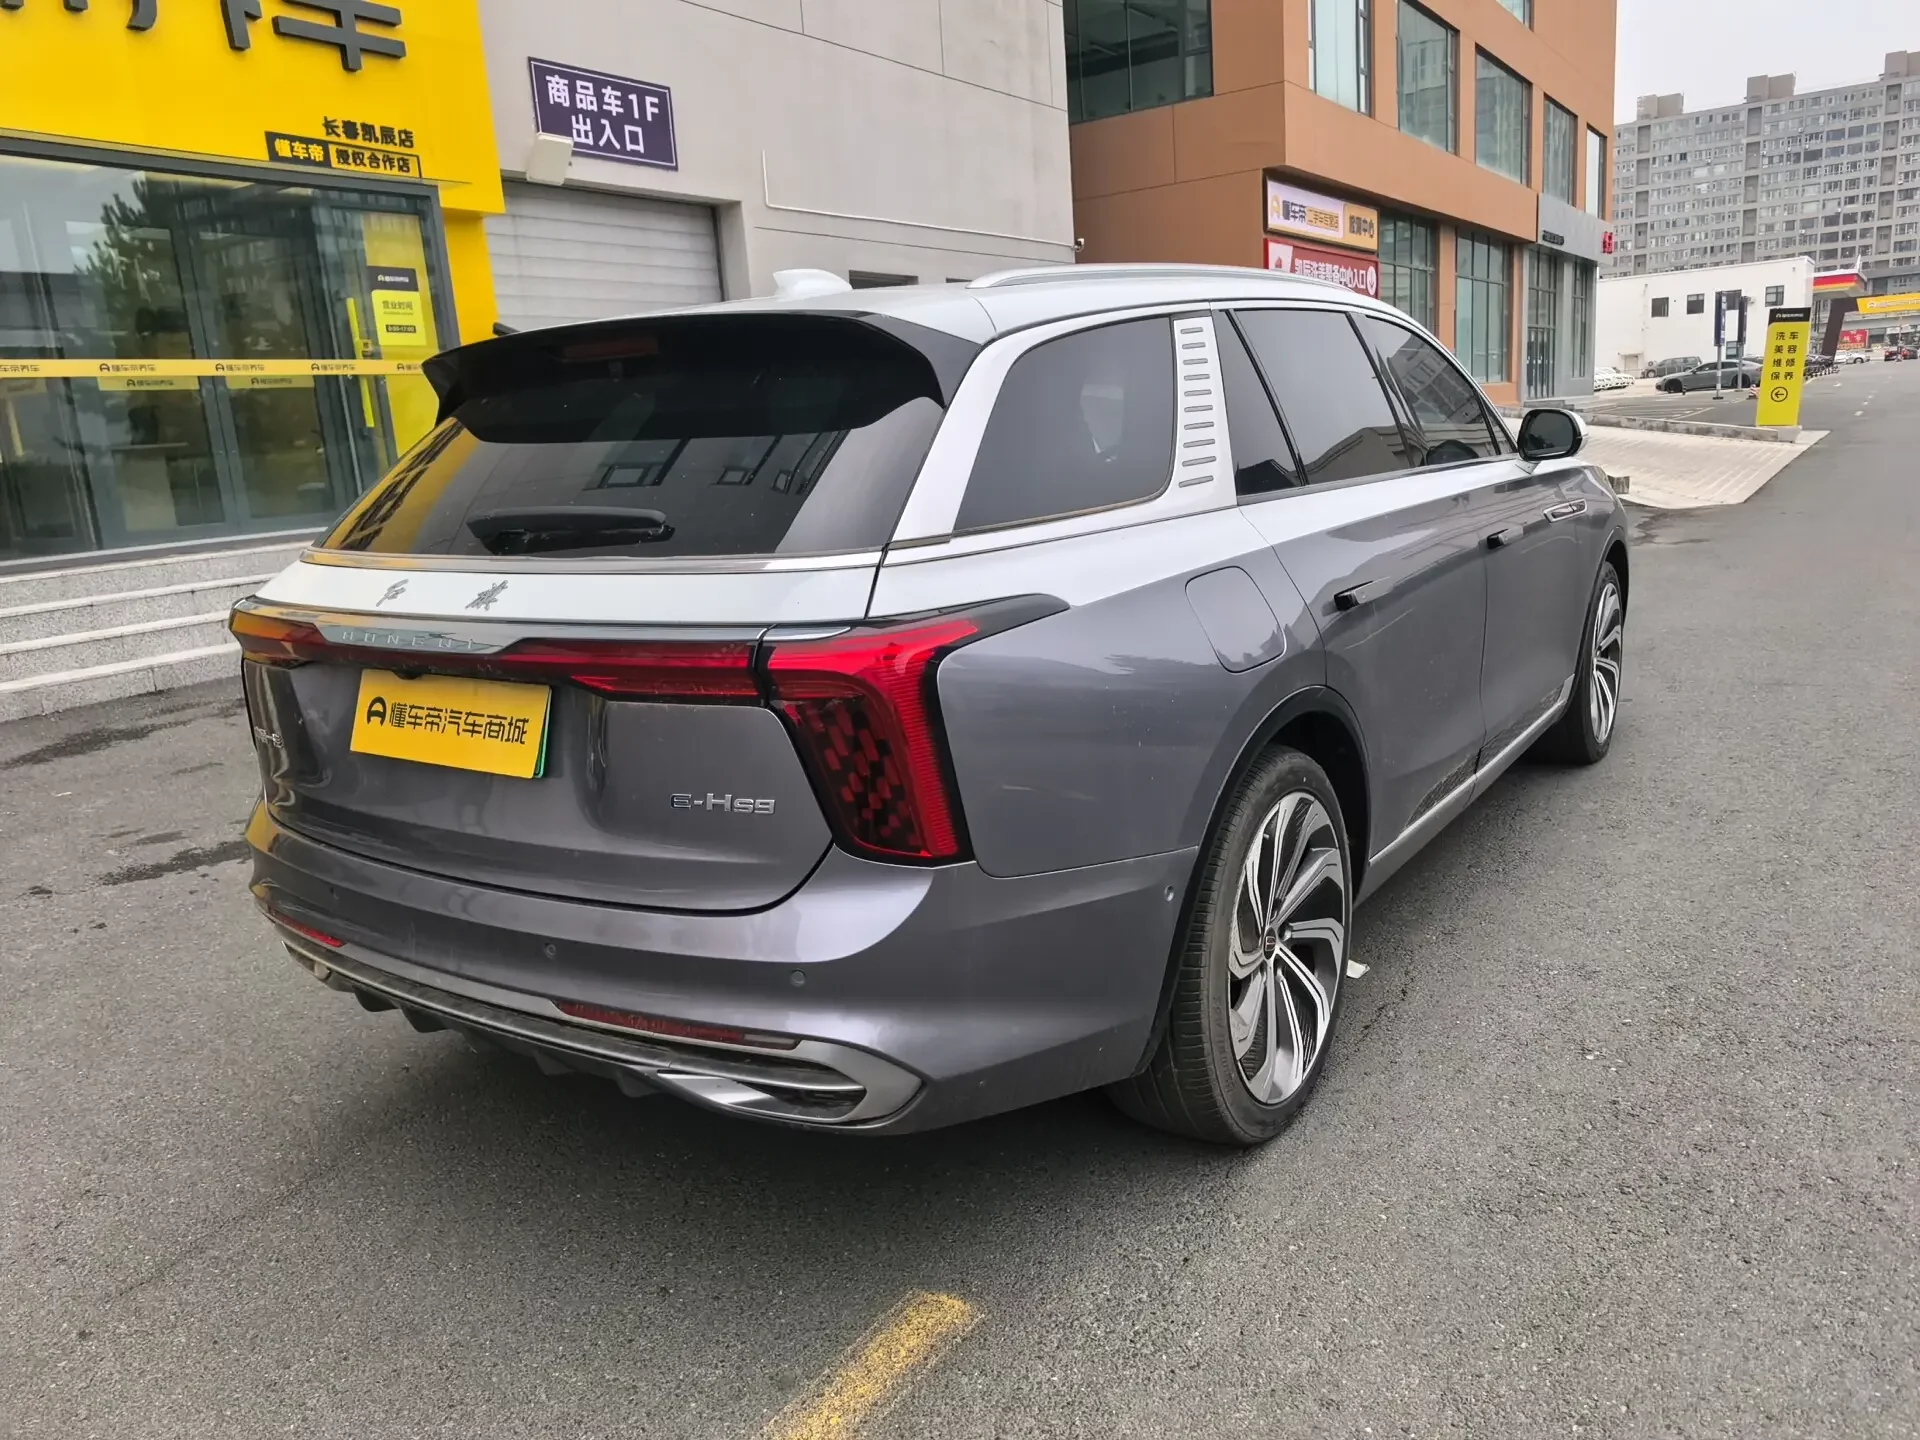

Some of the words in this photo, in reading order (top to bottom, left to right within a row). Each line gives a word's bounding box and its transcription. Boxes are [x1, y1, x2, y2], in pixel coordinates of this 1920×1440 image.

[545, 74, 659, 121] 商品车1F
[322, 116, 414, 148] 长春凯辰店
[571, 113, 645, 154] 出入口
[274, 138, 324, 162] 懂车帝
[335, 147, 411, 173] 授权合作店
[1774, 345, 1797, 354] 美容
[1776, 331, 1799, 341] 洗车
[1770, 371, 1794, 381] 保养
[1772, 358, 1795, 368] 维修
[389, 701, 530, 745] 懂车帝汽车商城
